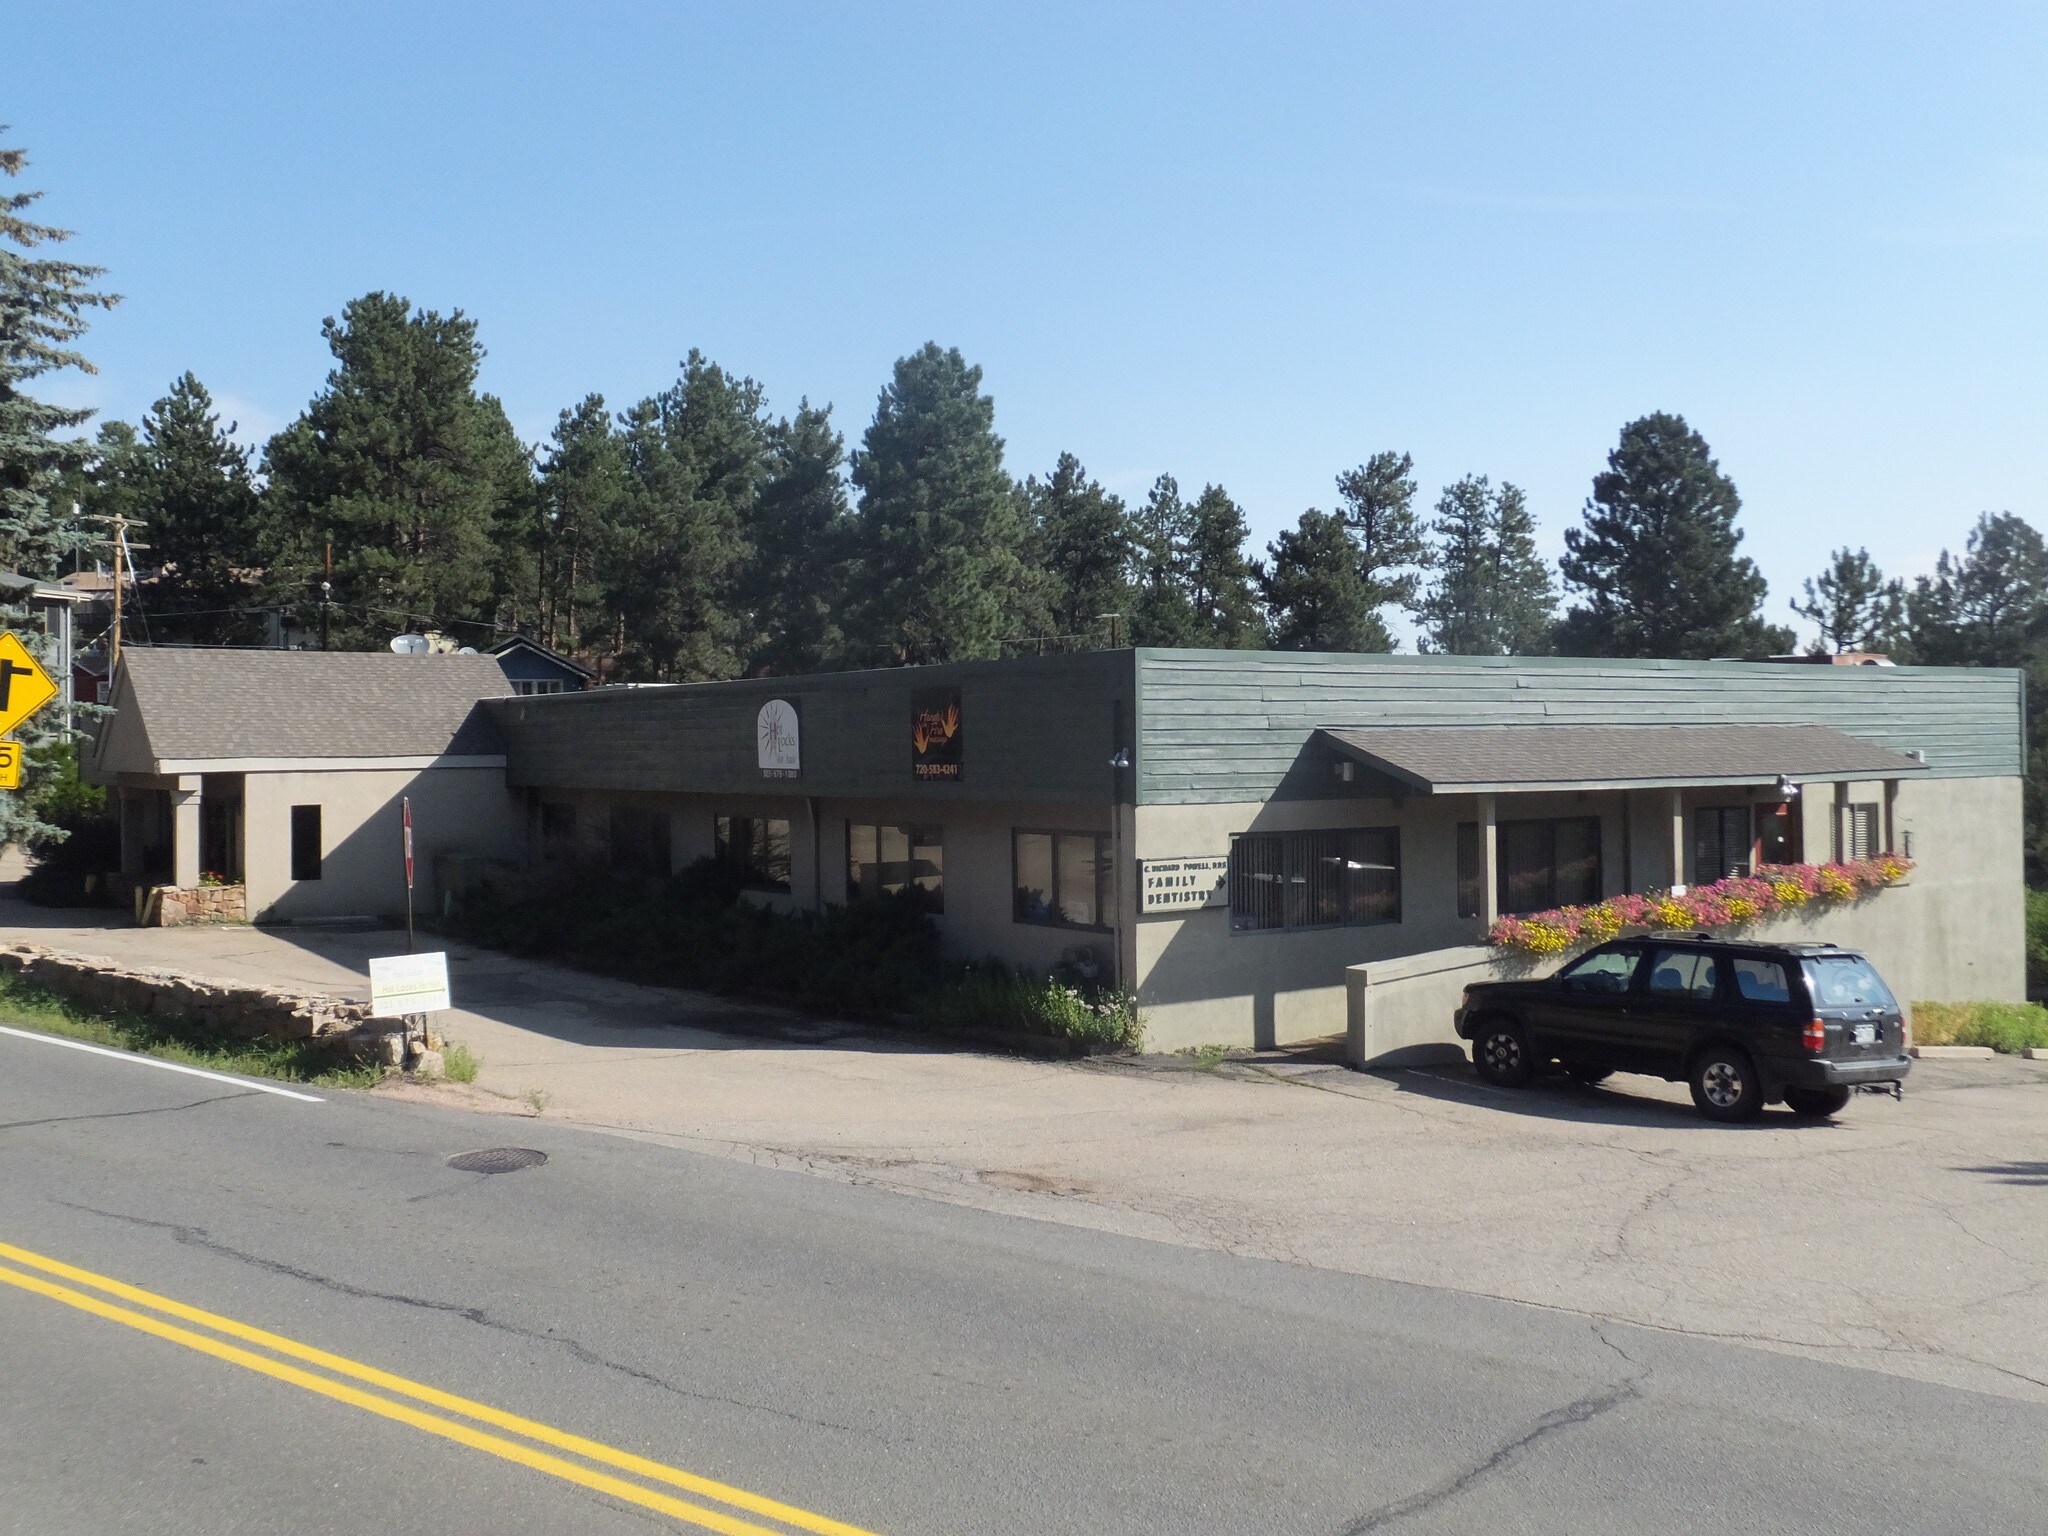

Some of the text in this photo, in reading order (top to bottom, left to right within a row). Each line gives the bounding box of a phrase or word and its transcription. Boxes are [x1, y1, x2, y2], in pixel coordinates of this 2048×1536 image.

[769, 722, 783, 740] Hot
[778, 733, 796, 752] Locks
[915, 764, 958, 774] 720-583-4241
[1152, 864, 1180, 872] RICHARD
[1148, 875, 1196, 888] FAMILY
[1148, 890, 1213, 905] DENTISTRY
[382, 983, 394, 993] Hot
[397, 982, 418, 992] Locks
